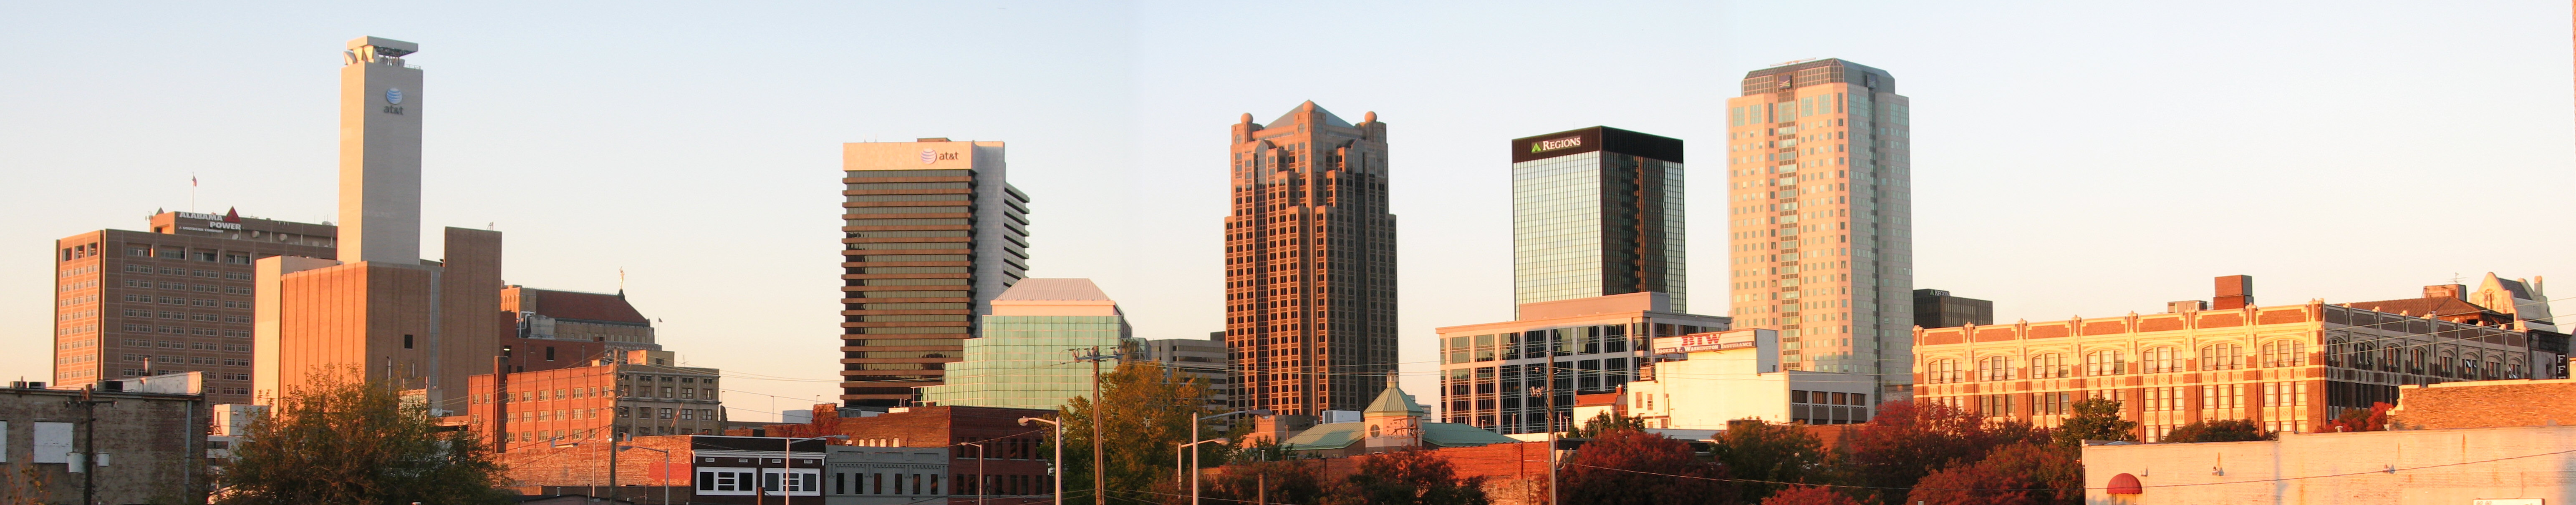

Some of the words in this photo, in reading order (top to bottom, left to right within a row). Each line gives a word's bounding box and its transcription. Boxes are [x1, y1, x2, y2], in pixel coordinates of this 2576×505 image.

[384, 105, 403, 115] at&t
[1543, 137, 1581, 151] REGIONS
[939, 151, 959, 160] at&t
[179, 212, 223, 221] ALABAMA
[210, 221, 241, 230] POWER
[1681, 334, 1721, 346] BTW
